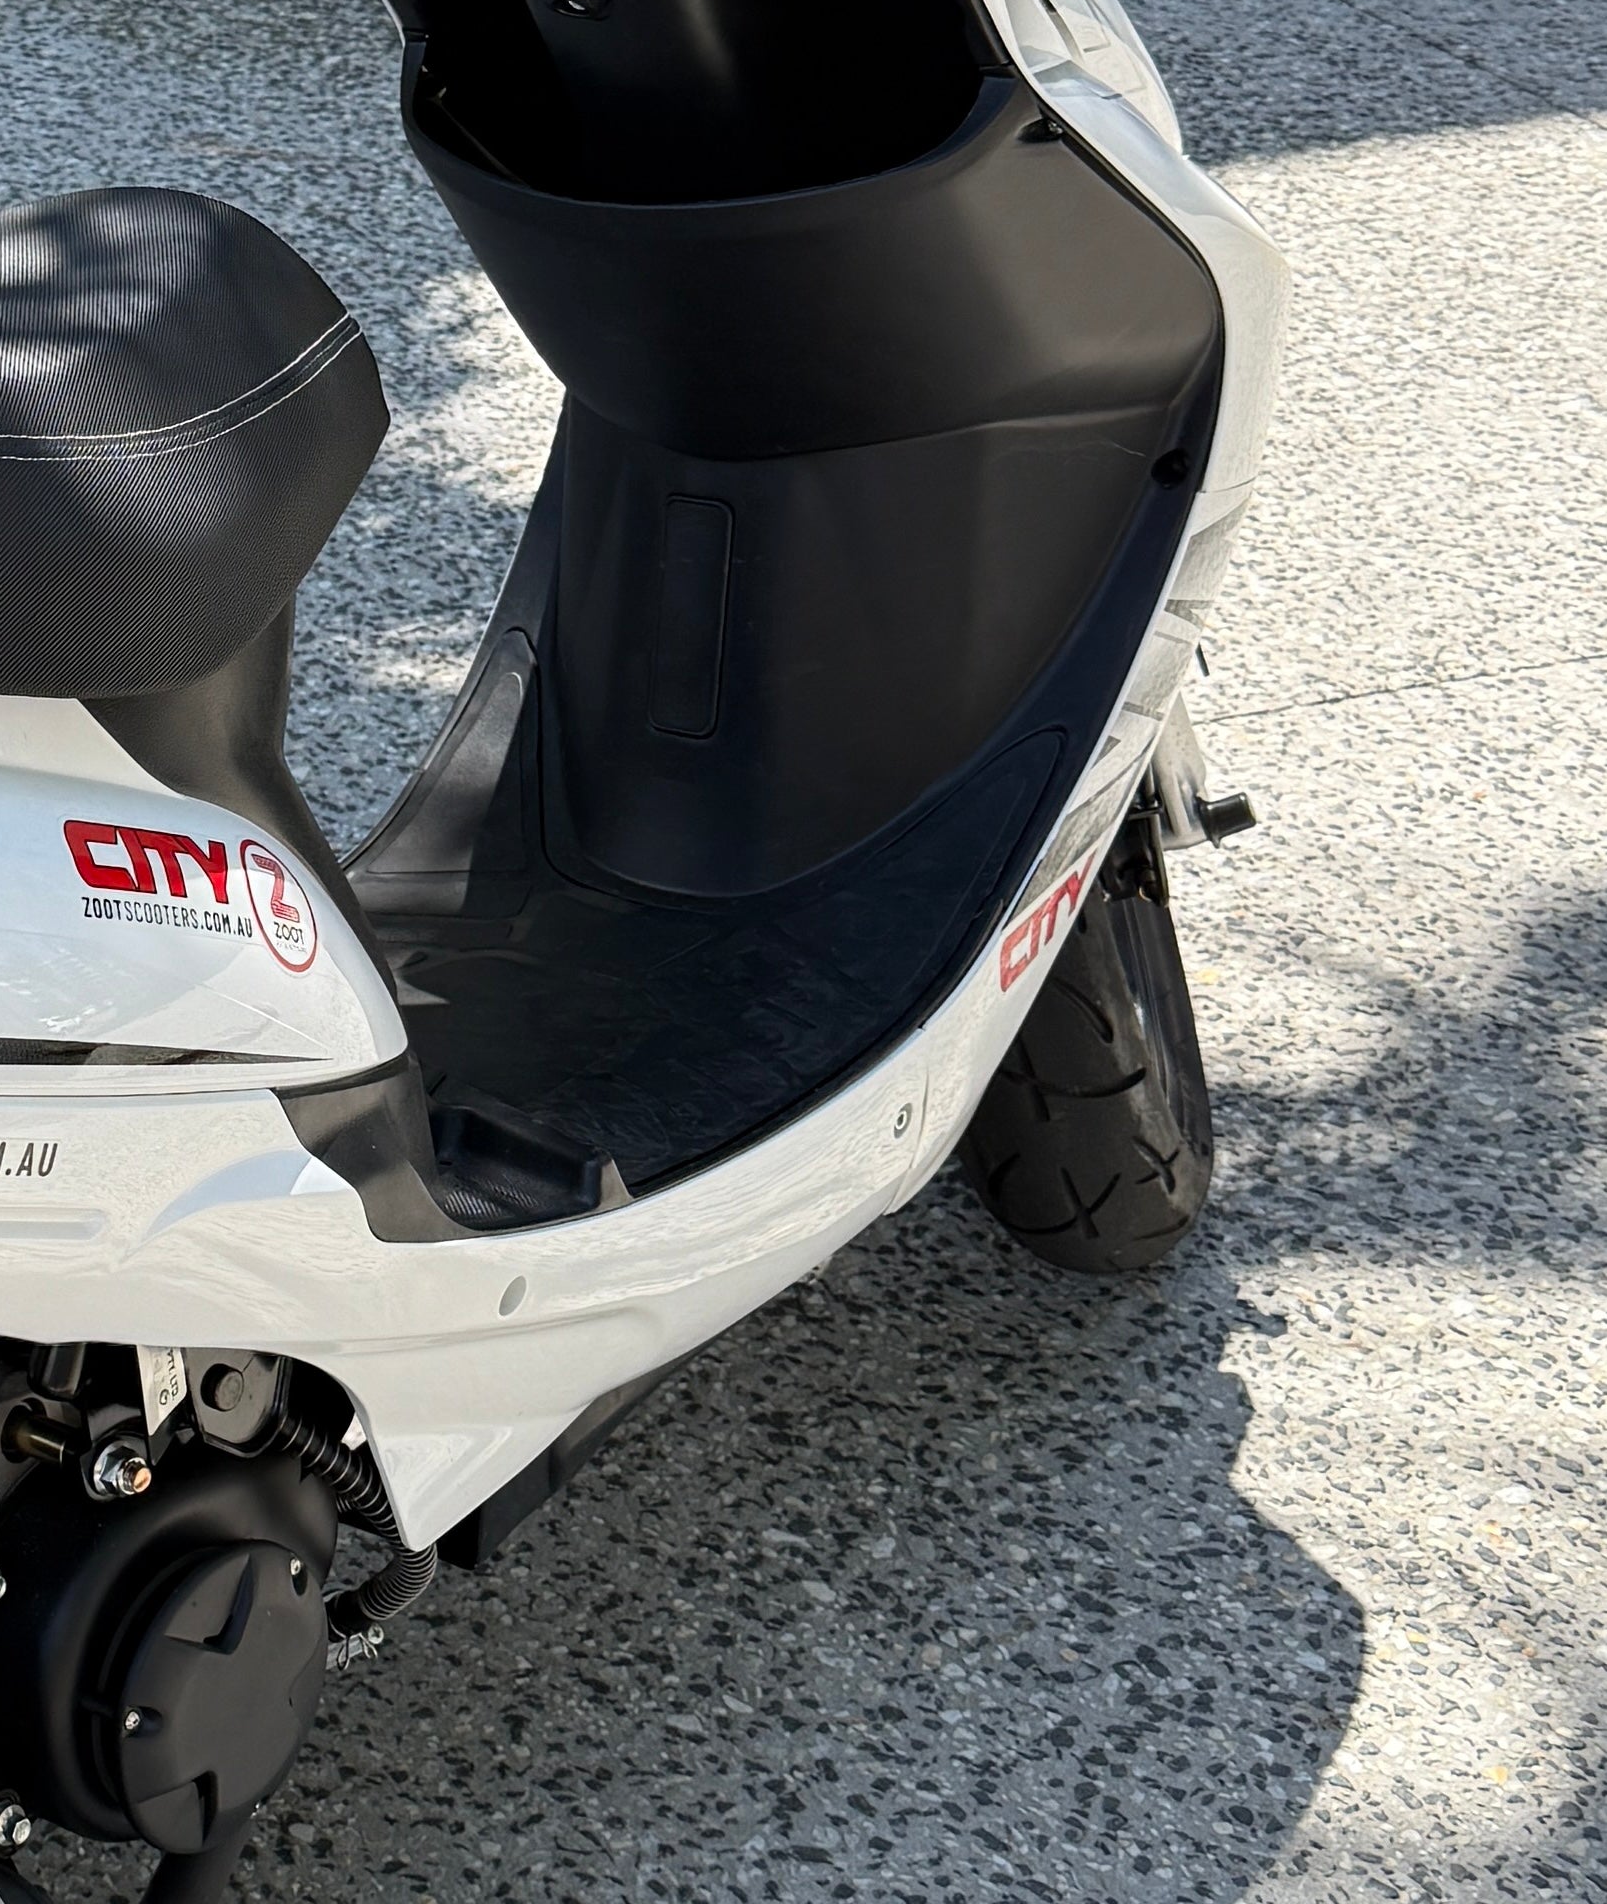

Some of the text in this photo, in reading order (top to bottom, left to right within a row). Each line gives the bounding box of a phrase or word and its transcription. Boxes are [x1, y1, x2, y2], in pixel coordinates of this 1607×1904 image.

[63, 819, 230, 905] CITY
[81, 897, 253, 938] ZOOTSCOOTERS.COM.AU
[274, 921, 305, 945] ZOOT
[999, 848, 1098, 993] CITY
